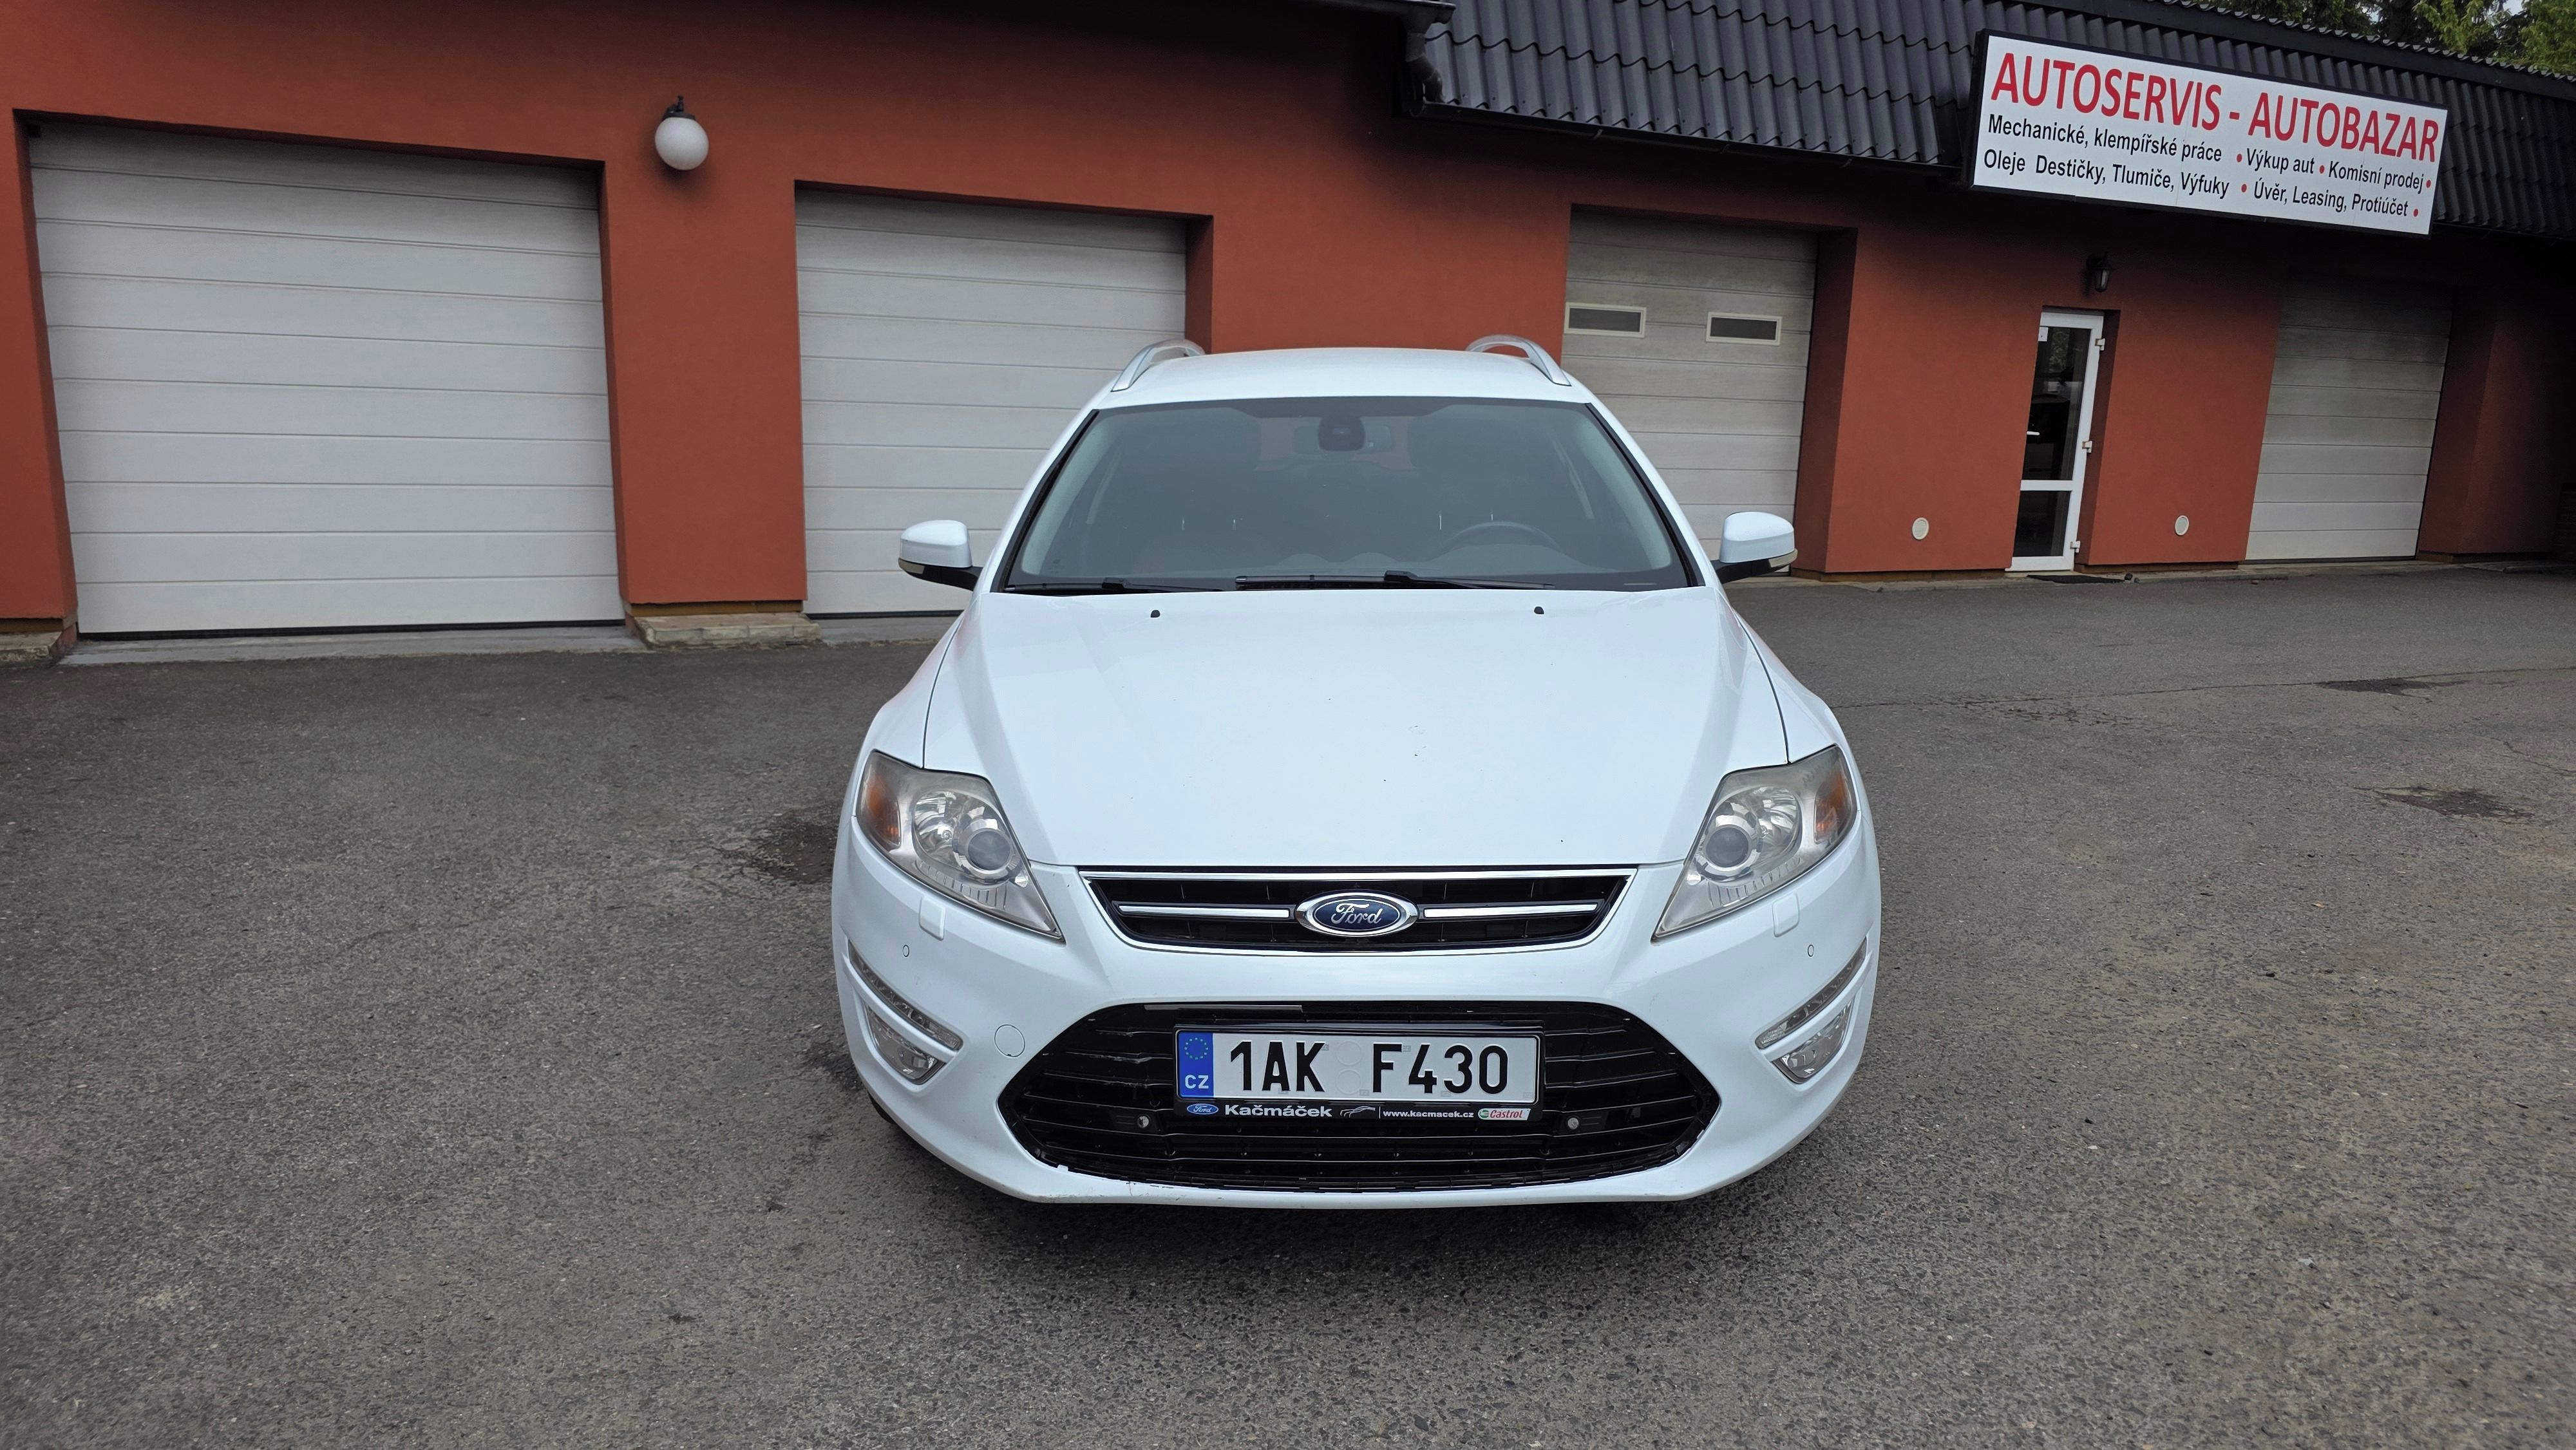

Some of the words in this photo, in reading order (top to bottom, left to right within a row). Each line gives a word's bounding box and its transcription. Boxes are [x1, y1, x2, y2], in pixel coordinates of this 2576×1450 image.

[1991, 52, 2222, 131] AUTOSERVIS
[2229, 111, 2240, 120] -
[2248, 92, 2439, 162] AUTOBAZAR
[1987, 113, 2088, 149] Mechanické,
[2094, 127, 2177, 156] klempířské
[2181, 141, 2222, 162] práce
[2246, 147, 2289, 174] Výkup
[2293, 157, 2315, 174] aut
[2328, 160, 2383, 185] Komisní
[2383, 171, 2424, 194] prodej
[1984, 149, 2025, 176] Oleje
[2035, 155, 2106, 185] Destičky,
[2112, 164, 2174, 192] Tlumiče,
[2181, 171, 2230, 199] Výfuky
[2254, 177, 2287, 205] Úvěr,
[2292, 185, 2347, 212] Leasing,
[2351, 193, 2409, 216] Protiúčet
[1331, 903, 1384, 925] Ford
[1230, 1040, 1325, 1092] 1AK
[1372, 1042, 1508, 1094] F430
[1184, 1075, 1209, 1089] CZ
[1192, 1104, 1213, 1113] Ford
[1225, 1104, 1332, 1117] Kačmáček
[1490, 1109, 1523, 1118] Castrol
